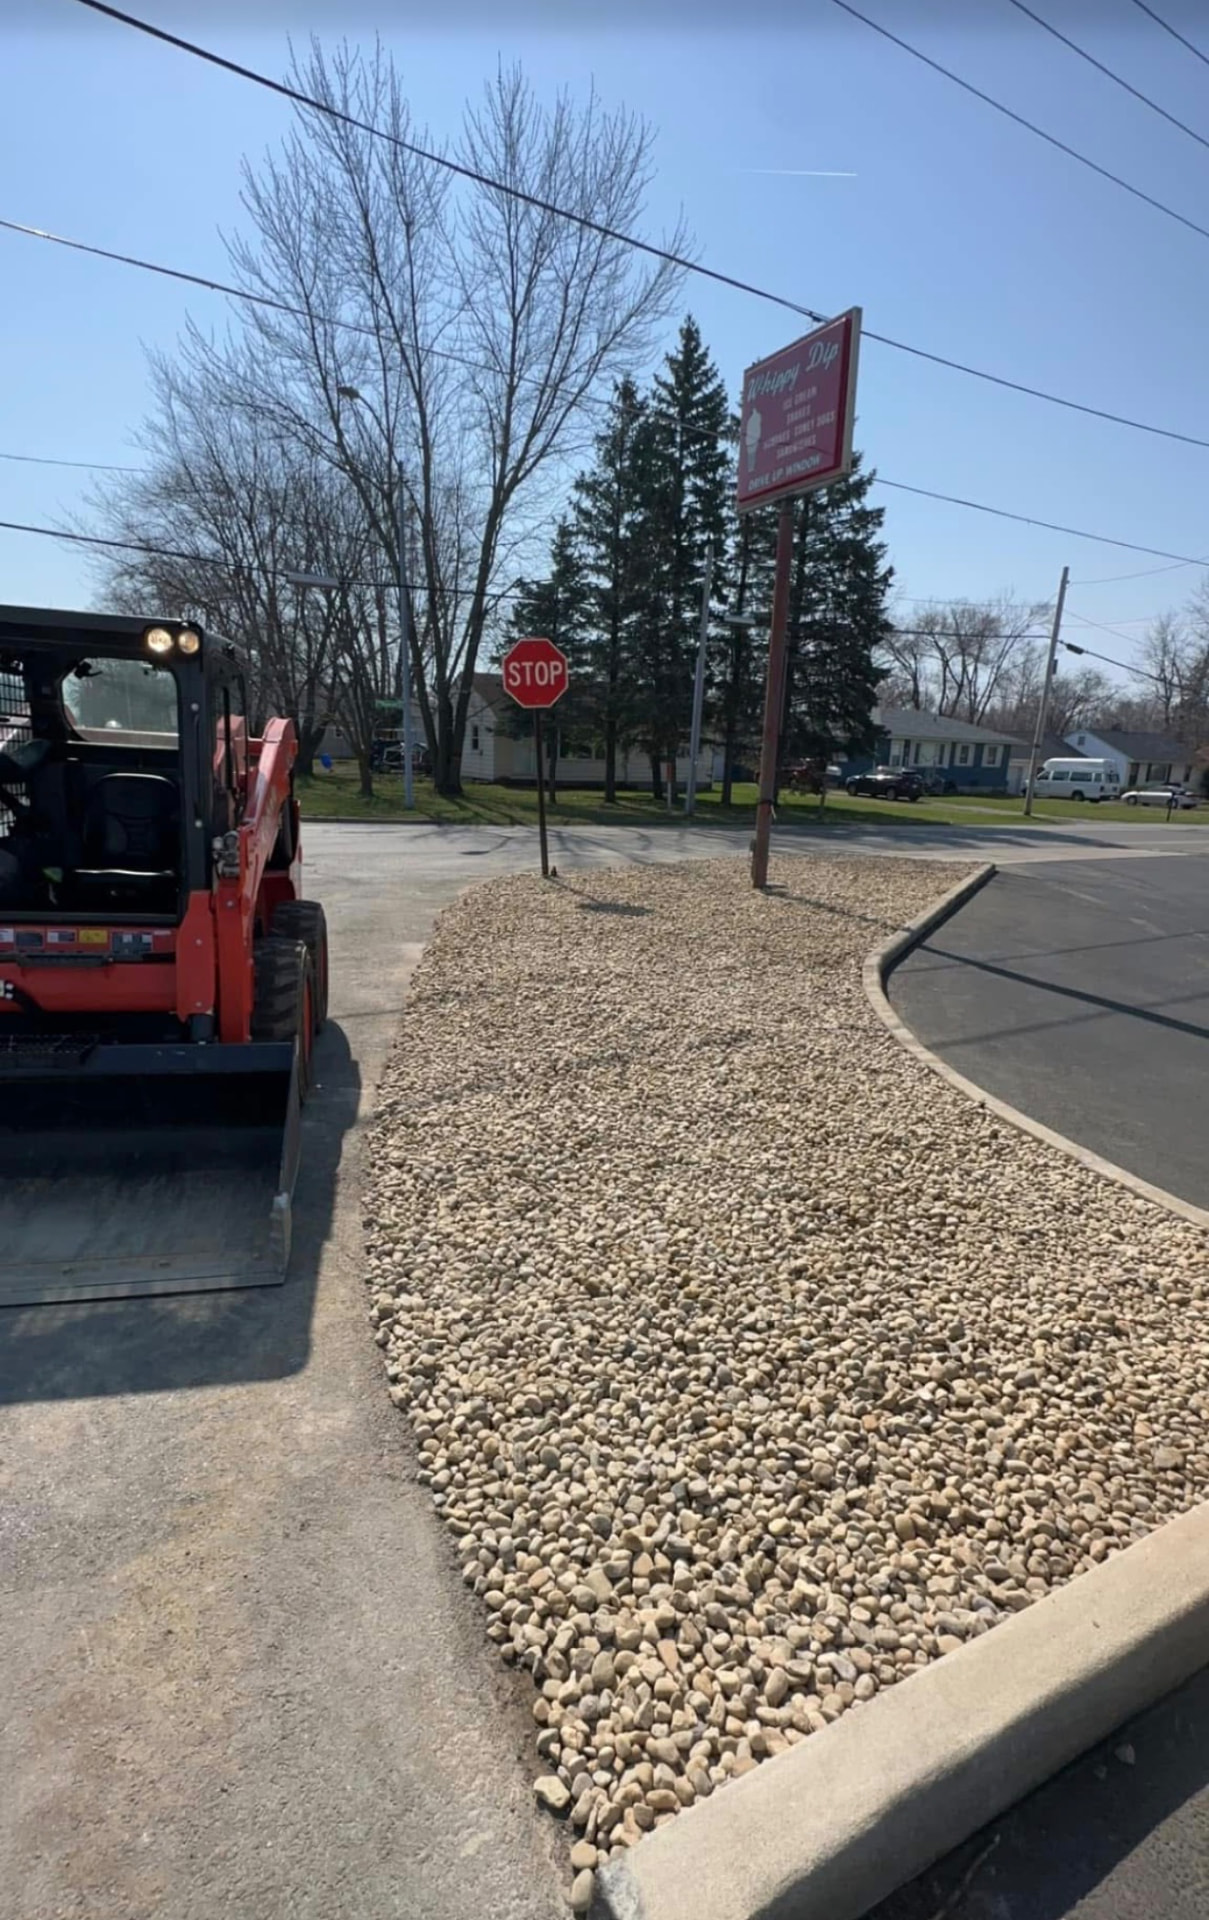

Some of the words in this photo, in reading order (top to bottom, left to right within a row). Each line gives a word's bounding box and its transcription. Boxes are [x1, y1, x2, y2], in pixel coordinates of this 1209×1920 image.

[747, 361, 800, 403] Whippy
[805, 341, 839, 371] Dip
[772, 467, 784, 482] UP
[785, 453, 821, 476] WINDOW
[508, 661, 563, 687] STOP
